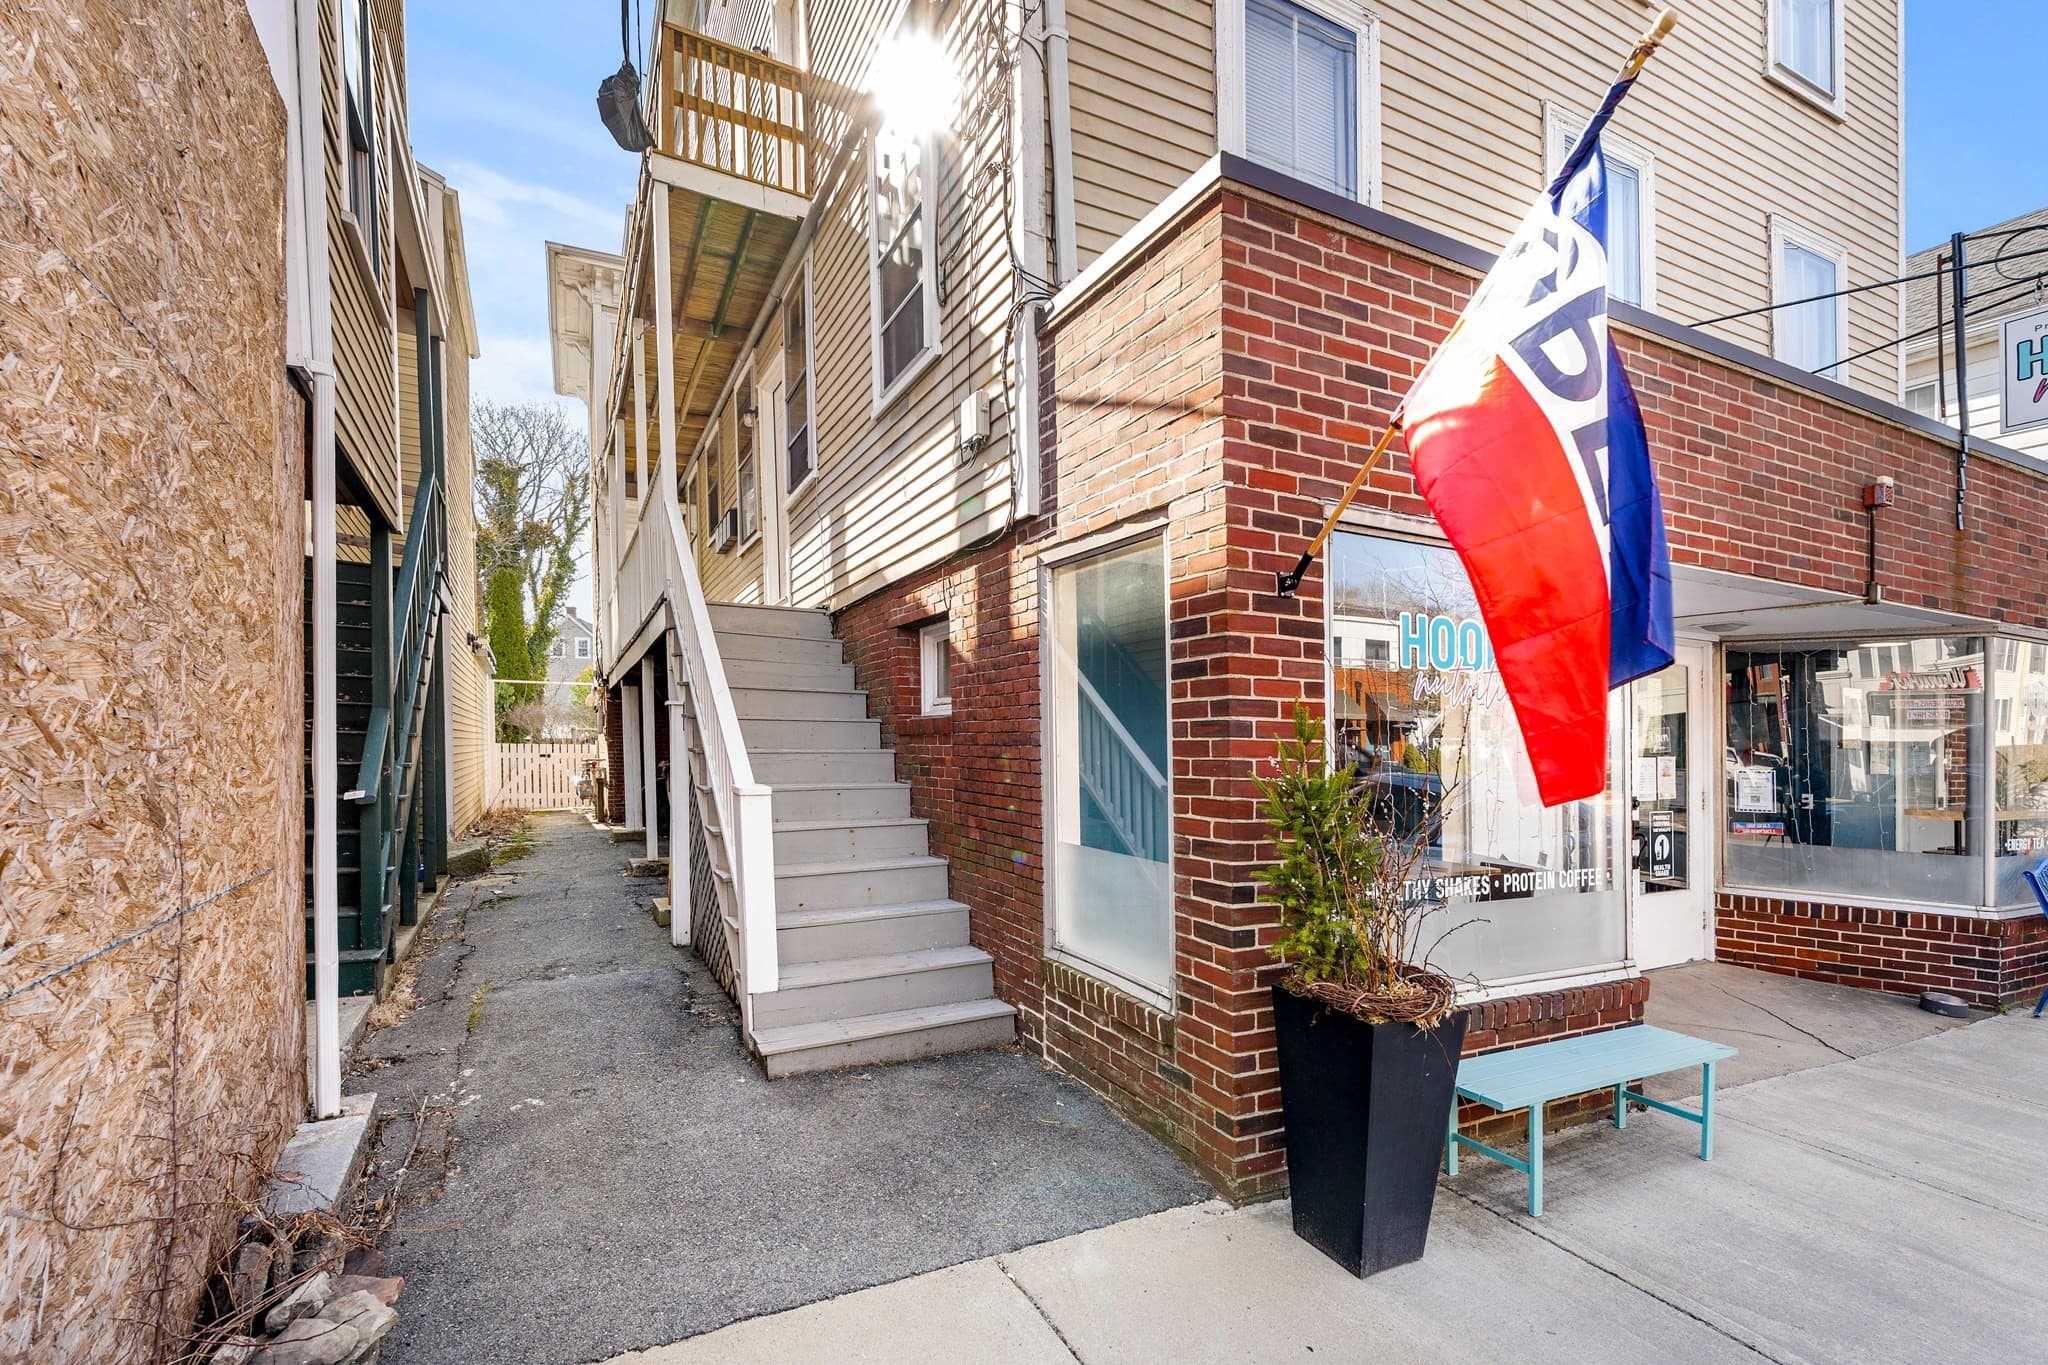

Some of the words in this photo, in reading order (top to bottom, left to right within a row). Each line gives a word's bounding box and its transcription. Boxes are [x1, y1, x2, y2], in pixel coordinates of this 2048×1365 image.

[2033, 837, 2045, 849] TEA
[1435, 875, 1490, 898] SHAKES
[1503, 868, 1555, 893] PROTEIN
[1559, 867, 1602, 888] COFFEE
